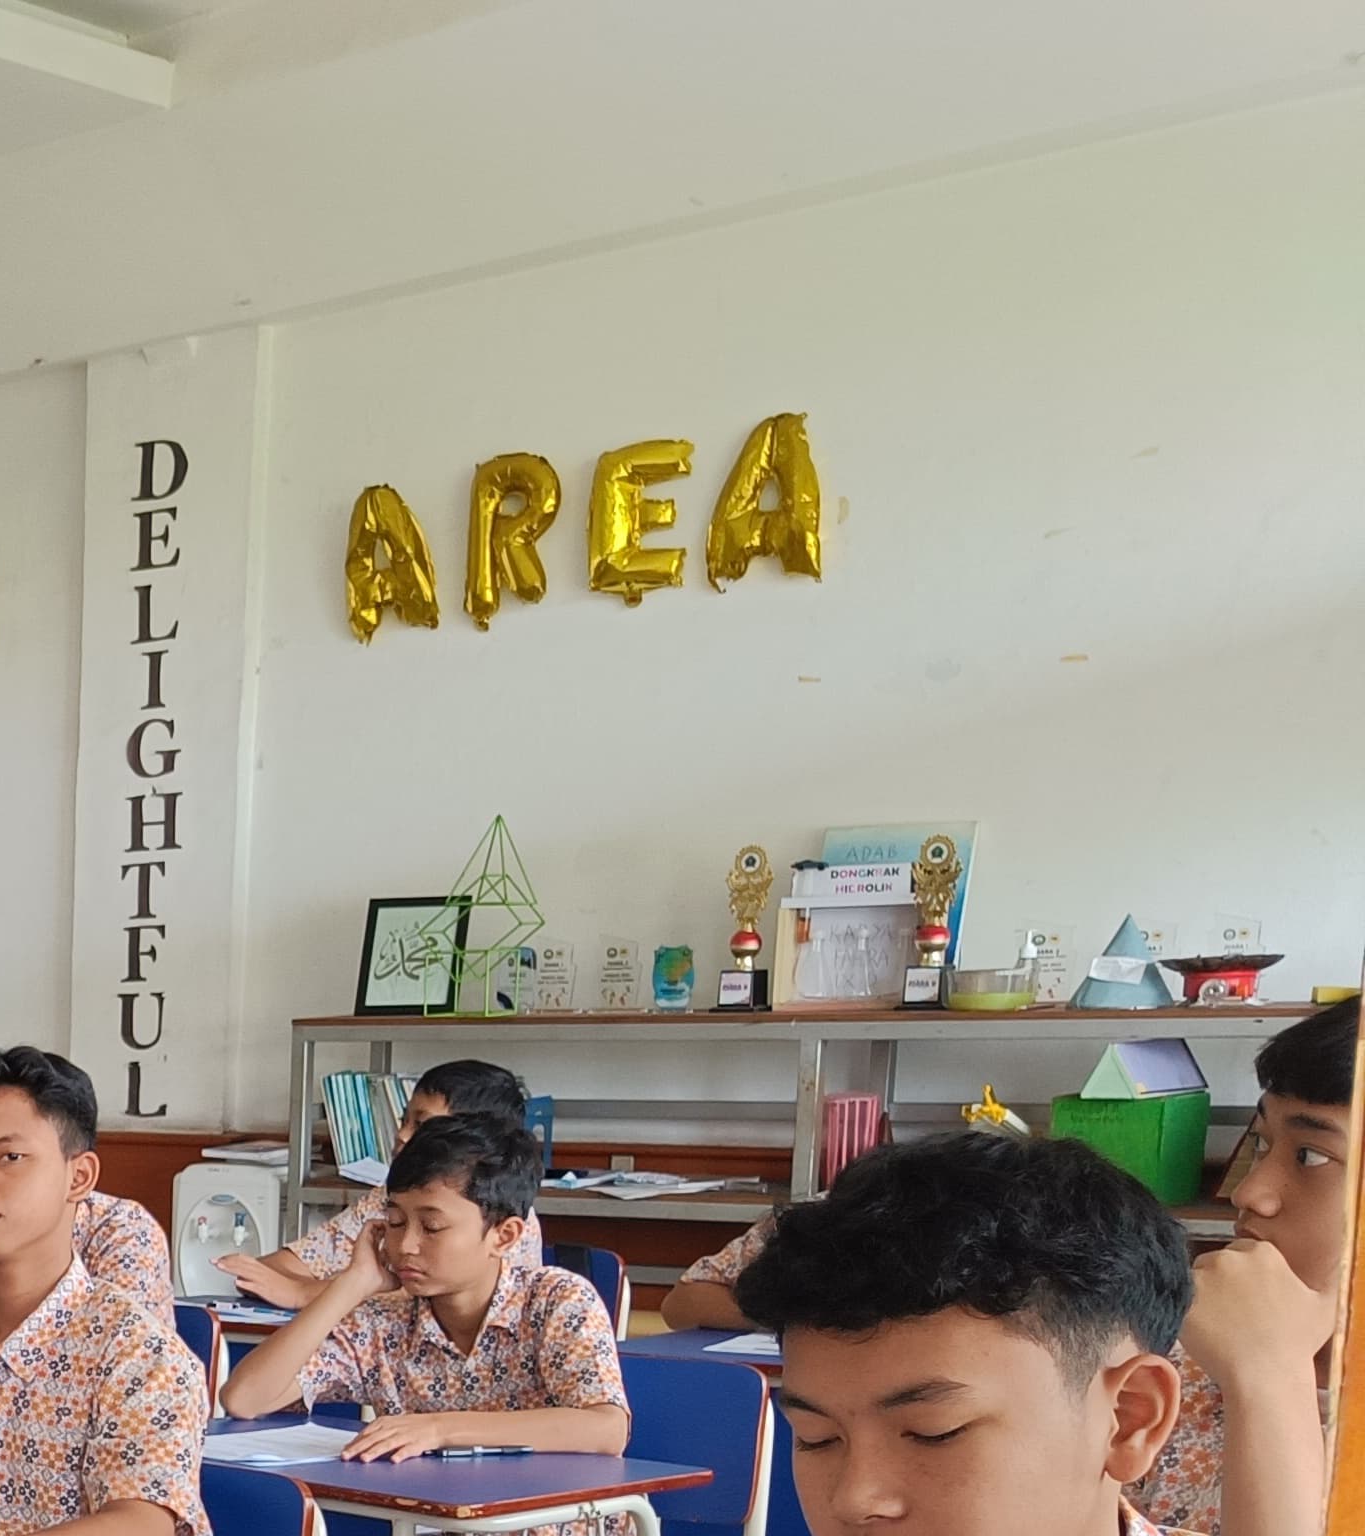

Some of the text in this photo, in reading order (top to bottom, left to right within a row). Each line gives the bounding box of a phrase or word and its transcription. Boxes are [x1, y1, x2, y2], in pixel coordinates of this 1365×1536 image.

[344, 411, 822, 647] AREA
[118, 439, 188, 1118] DELIGHTFUL
[830, 867, 900, 879] DONGKRAK
